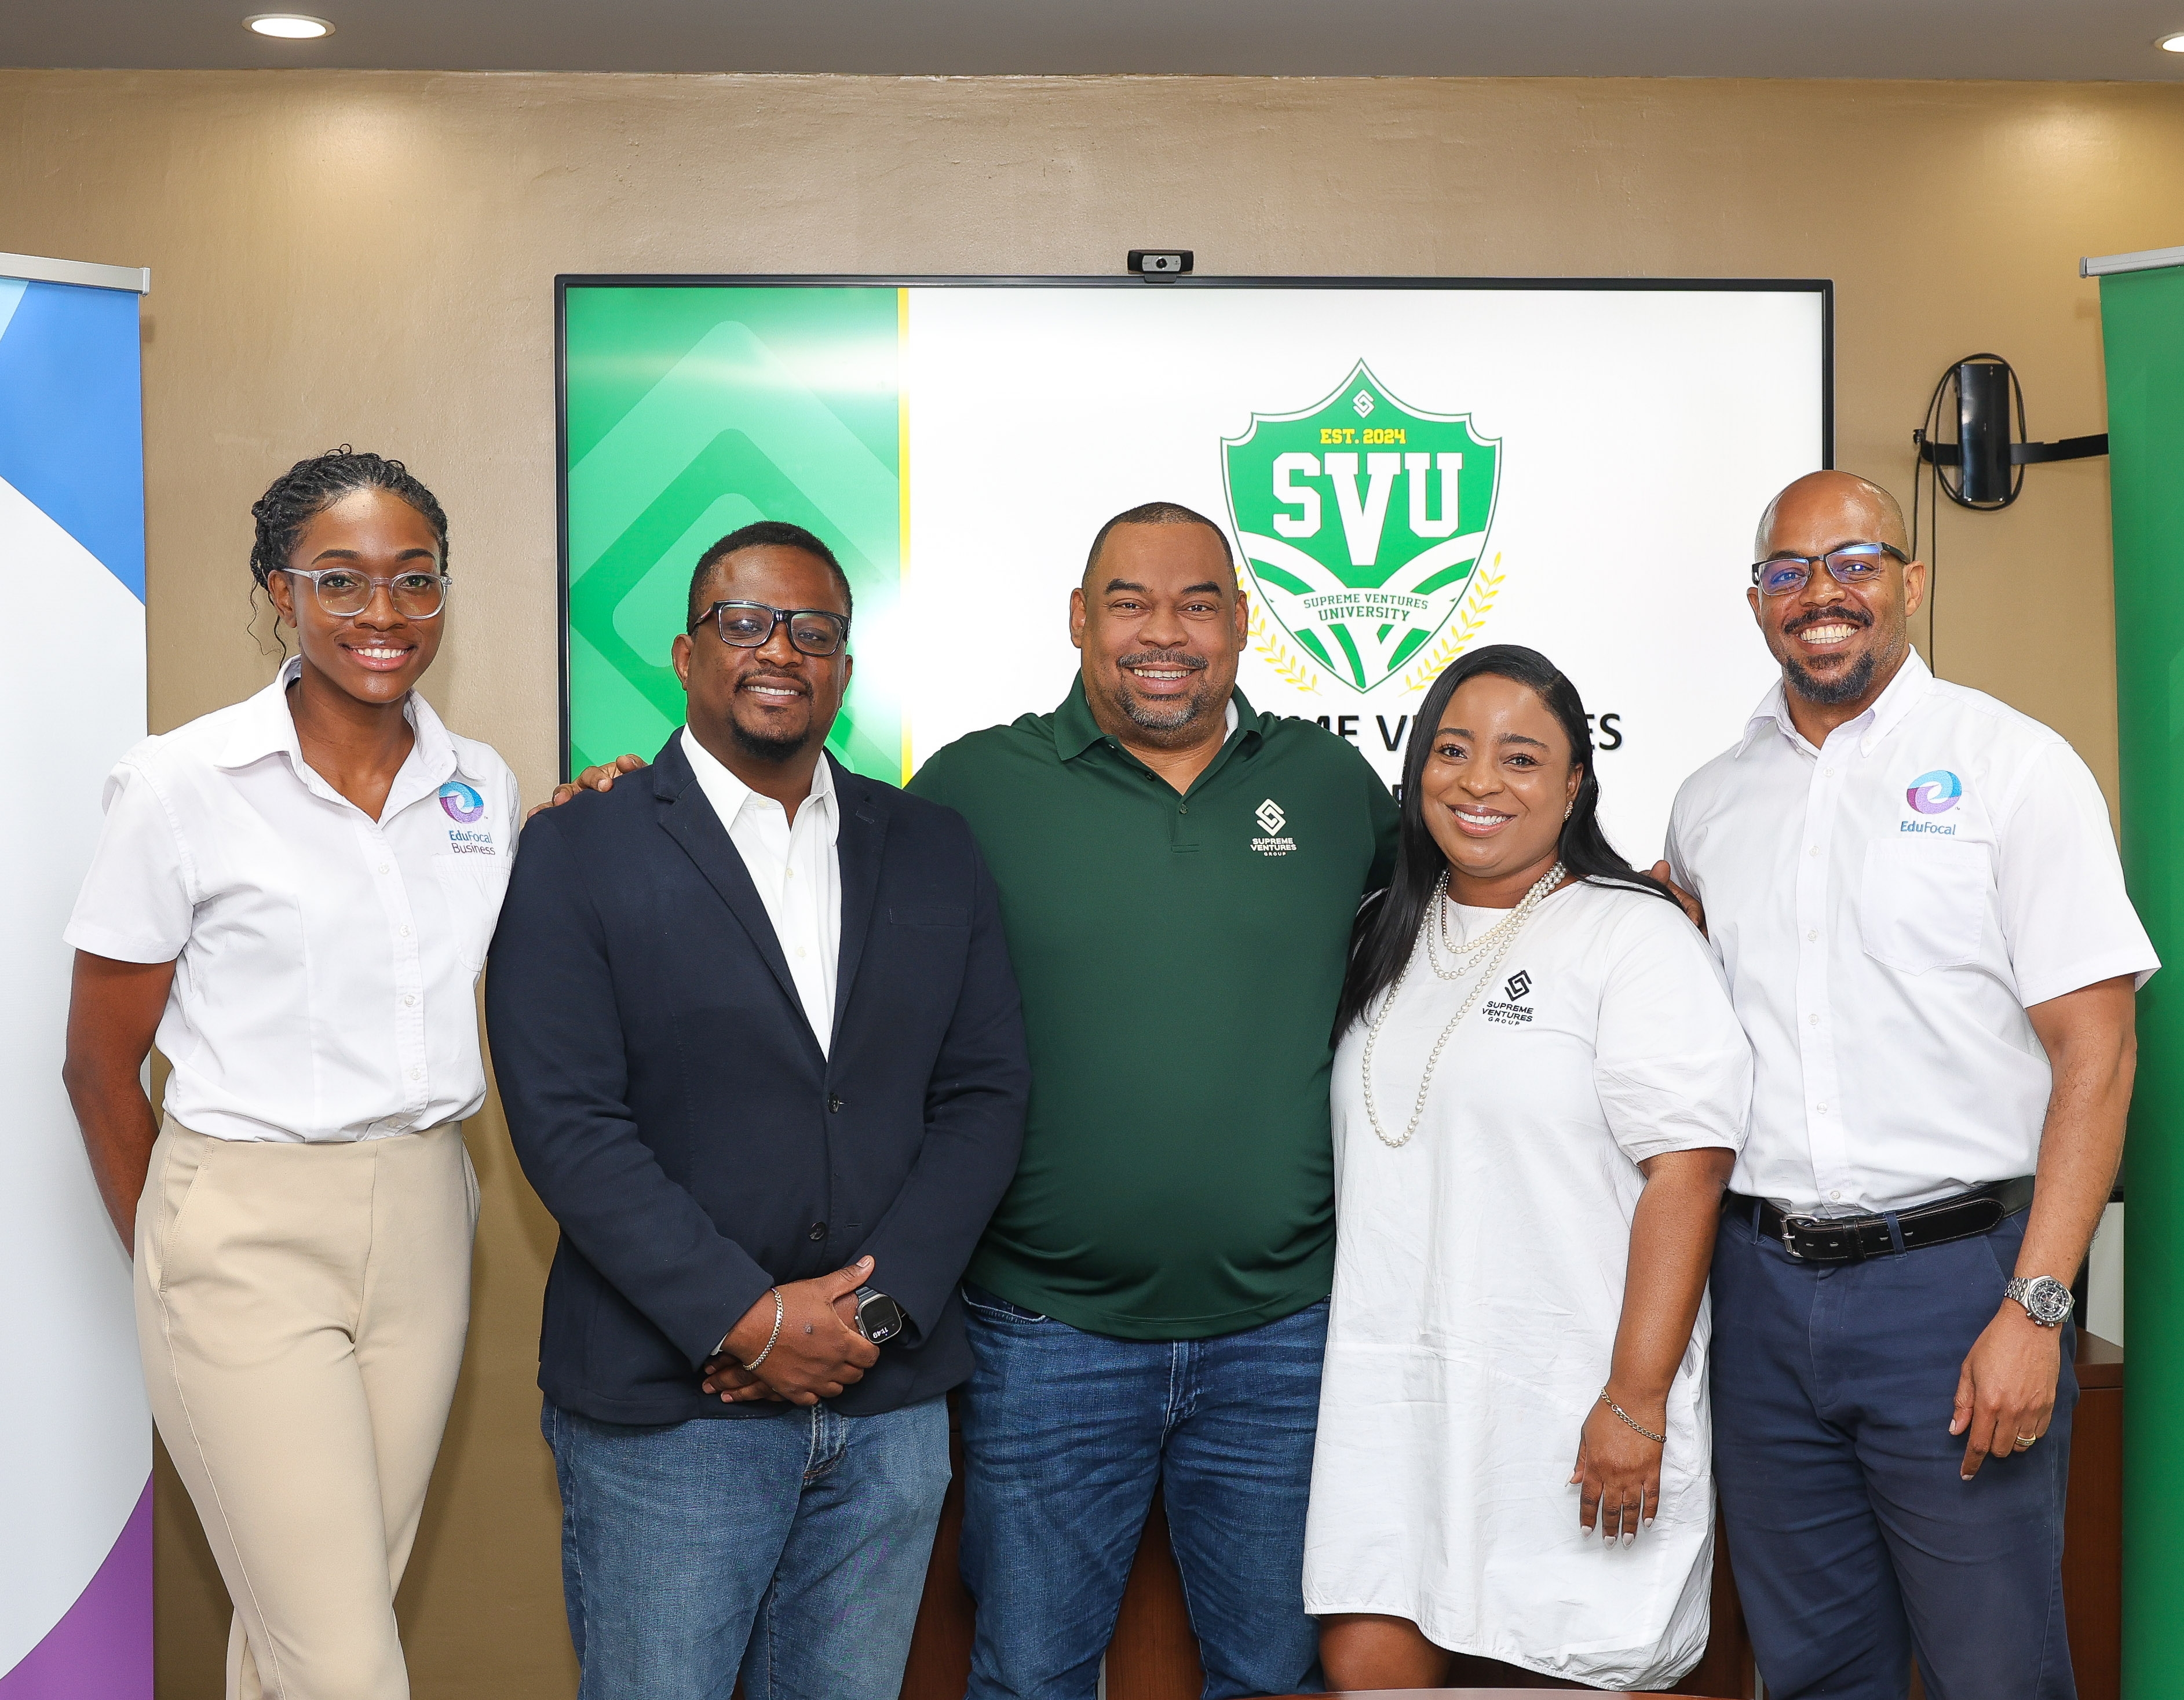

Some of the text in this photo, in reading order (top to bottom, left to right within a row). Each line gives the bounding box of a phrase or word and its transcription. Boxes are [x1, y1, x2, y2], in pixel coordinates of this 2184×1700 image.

[1320, 428, 1407, 444] EST. 2024
[1272, 452, 1463, 566] SVU
[1304, 593, 1429, 610] SUPREME VENTURES
[1319, 606, 1410, 621] UNIVERSITY
[1901, 820, 1956, 835] EduFocal
[449, 830, 492, 843] EduFocal
[451, 842, 495, 855] Business
[1487, 1001, 1534, 1014] SUPREME
[1482, 1008, 1533, 1022] VENTURES
[1488, 1017, 1520, 1026] GROUP
